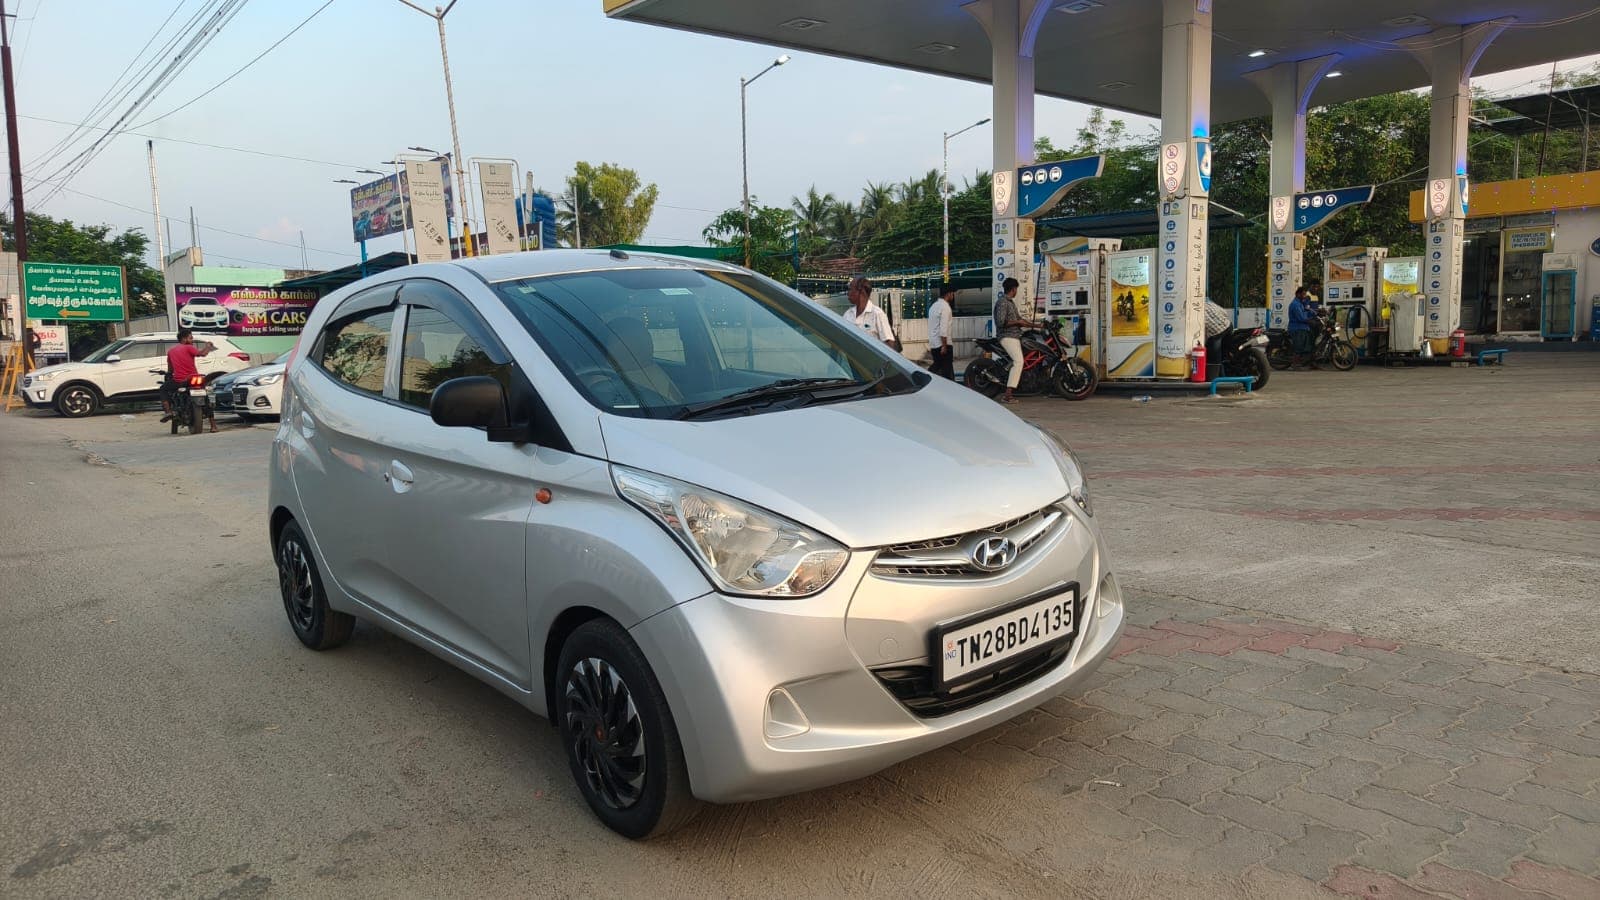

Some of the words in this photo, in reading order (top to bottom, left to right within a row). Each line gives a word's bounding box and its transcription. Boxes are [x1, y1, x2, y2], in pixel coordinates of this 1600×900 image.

[1024, 194, 1029, 206] 1
[1300, 215, 1307, 225] 3
[28, 294, 123, 308] அறிவுத்திருக்கோயில்
[247, 312, 267, 324] SM
[271, 311, 306, 324] CARS
[242, 326, 261, 334] Buying
[269, 326, 286, 334] Selling
[957, 600, 1072, 667] TN28BD4135
